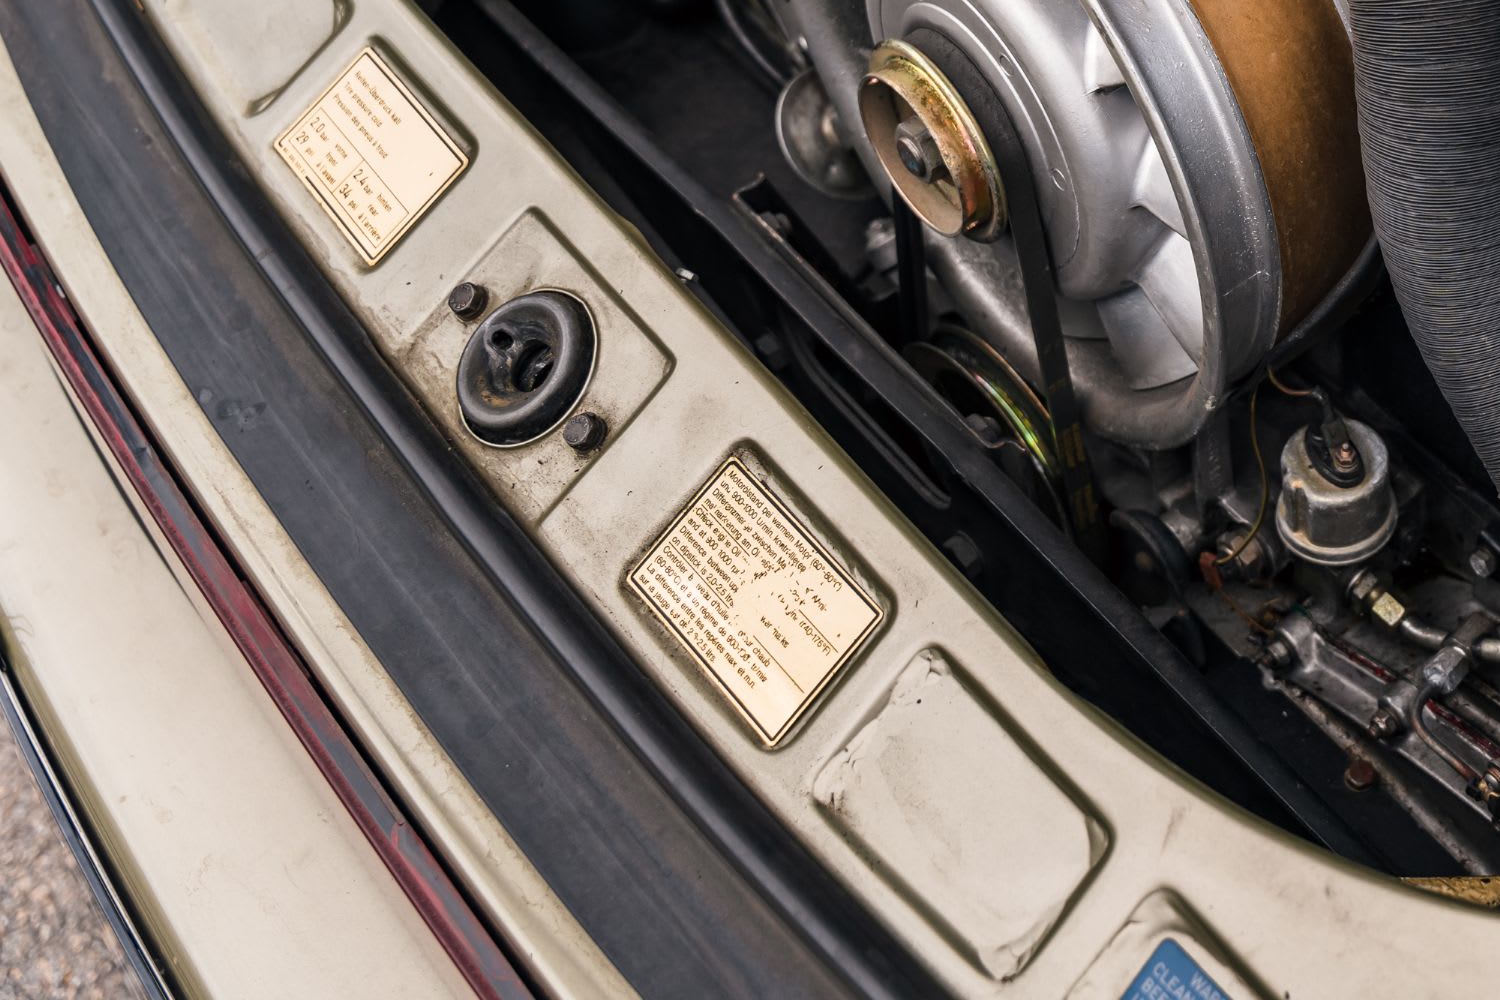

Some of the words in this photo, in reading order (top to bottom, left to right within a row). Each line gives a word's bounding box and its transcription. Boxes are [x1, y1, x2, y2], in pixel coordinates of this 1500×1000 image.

[352, 93, 372, 115] pressure
[296, 131, 309, 145] 29
[351, 115, 361, 126] des
[358, 125, 373, 142] pneus
[339, 183, 352, 198] 34
[367, 204, 378, 216] rear
[730, 490, 758, 520] 900-1000
[686, 516, 700, 531] and
[698, 527, 707, 539] at
[770, 516, 795, 543] warmem
[793, 539, 813, 560] Motor
[671, 535, 681, 547] on
[678, 543, 701, 569] dipstick
[699, 566, 708, 575] is
[678, 524, 708, 558] Difference
[706, 555, 732, 584] between
[741, 537, 752, 549] am
[751, 530, 778, 559] zwischen
[638, 573, 649, 586] sur
[652, 590, 670, 611] jauge
[646, 562, 657, 575] La
[679, 601, 696, 620] entre
[693, 616, 706, 630] les
[736, 665, 746, 676] et
[717, 624, 728, 637] de
